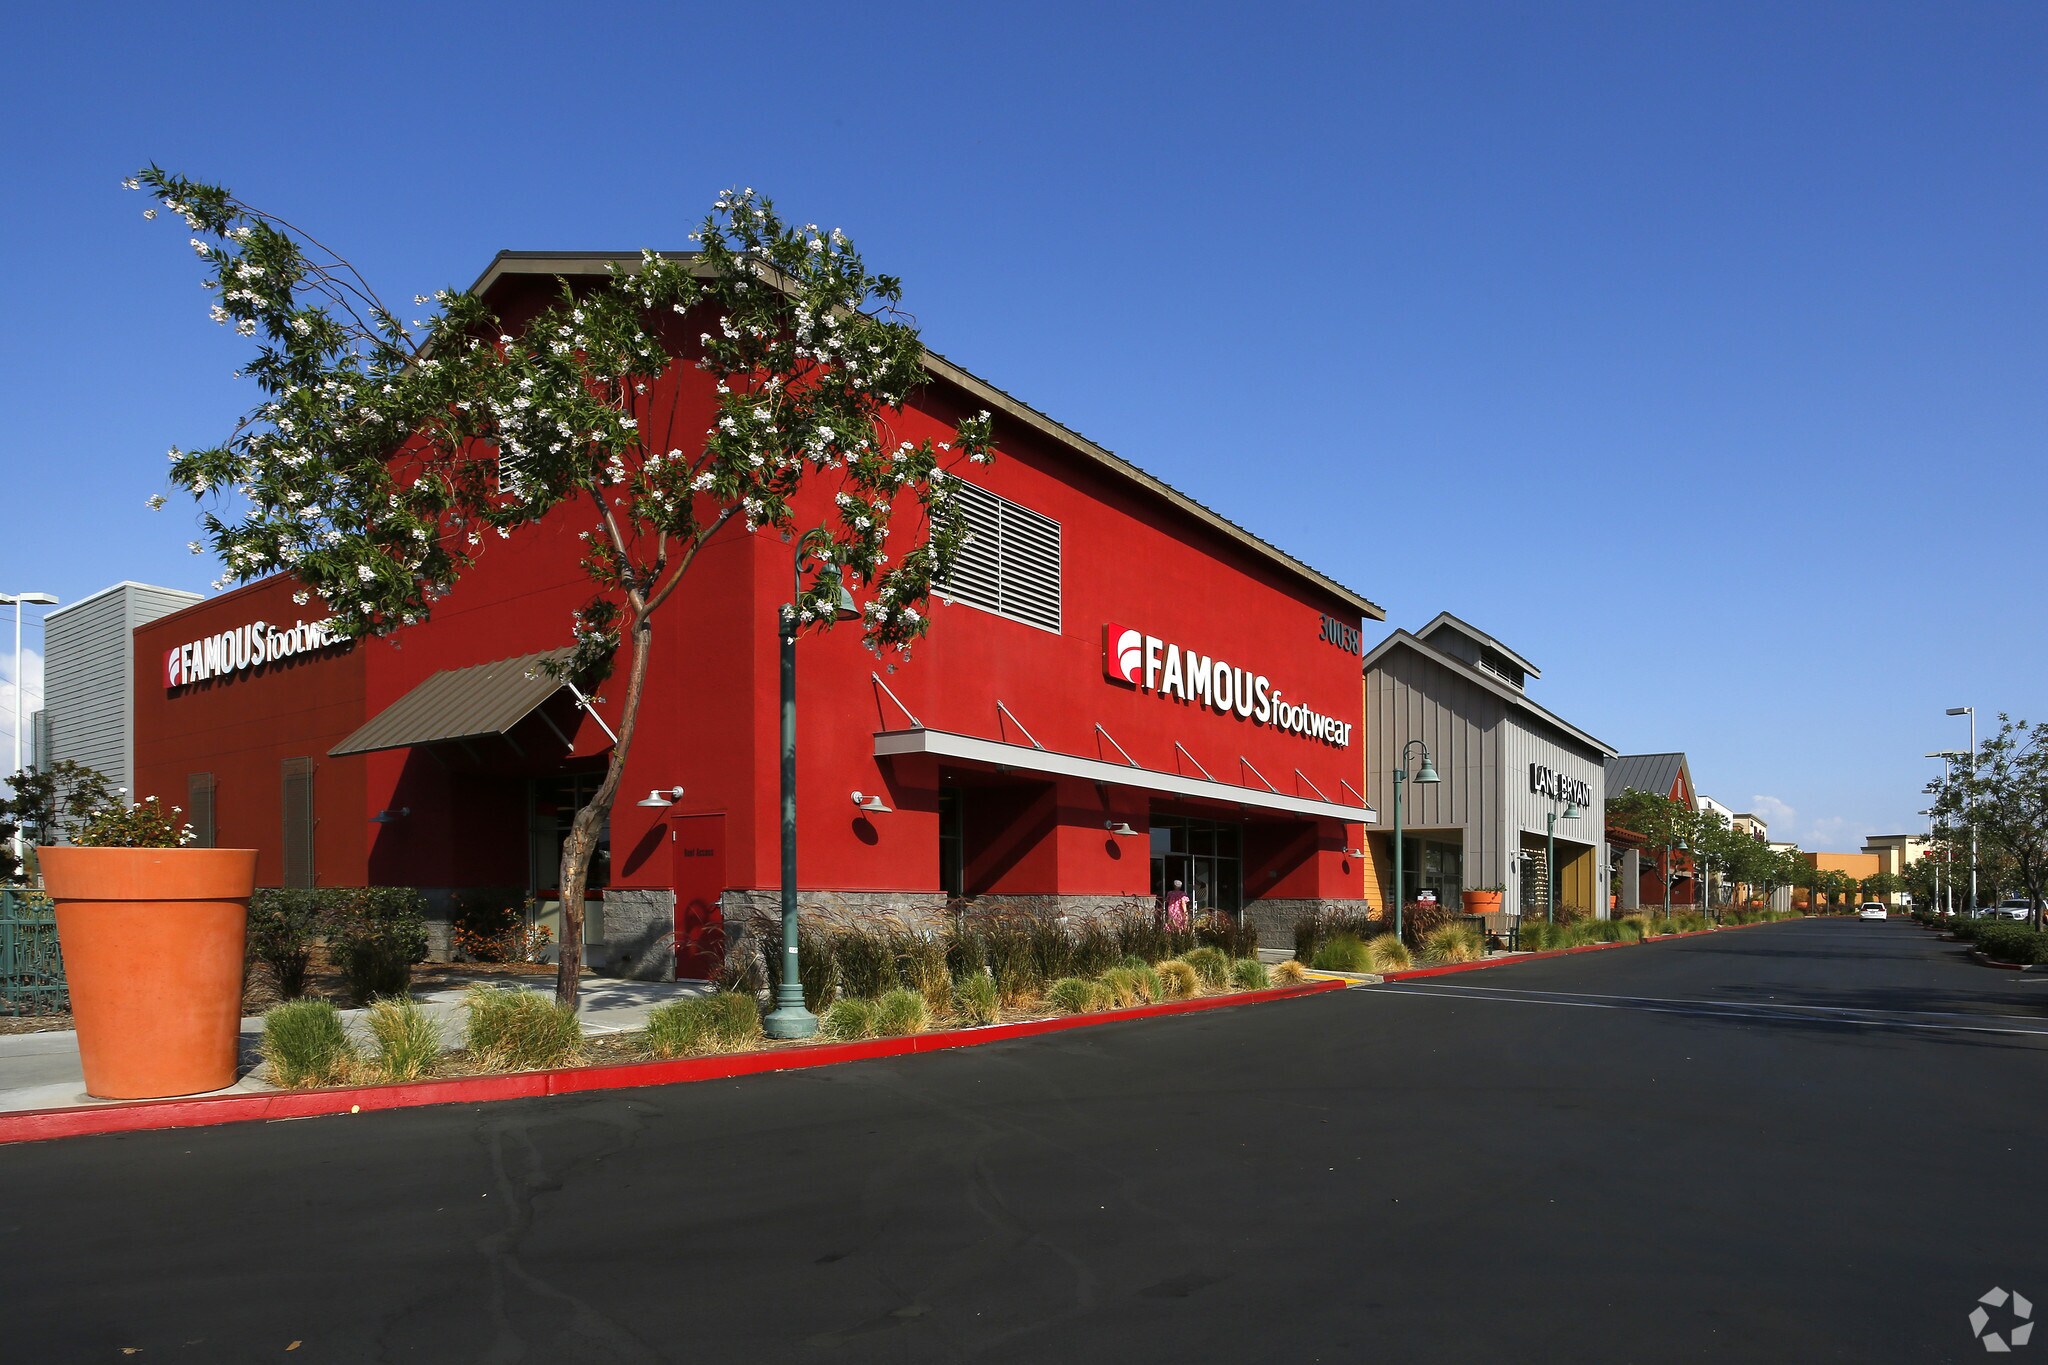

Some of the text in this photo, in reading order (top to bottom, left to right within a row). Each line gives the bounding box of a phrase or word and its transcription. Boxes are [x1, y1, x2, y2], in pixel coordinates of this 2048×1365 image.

[181, 620, 266, 685] FAMOUS
[1319, 613, 1360, 656] 30038
[1145, 634, 1352, 747] FAMOUS footwear
[1530, 763, 1593, 808] LANE BRYANT
